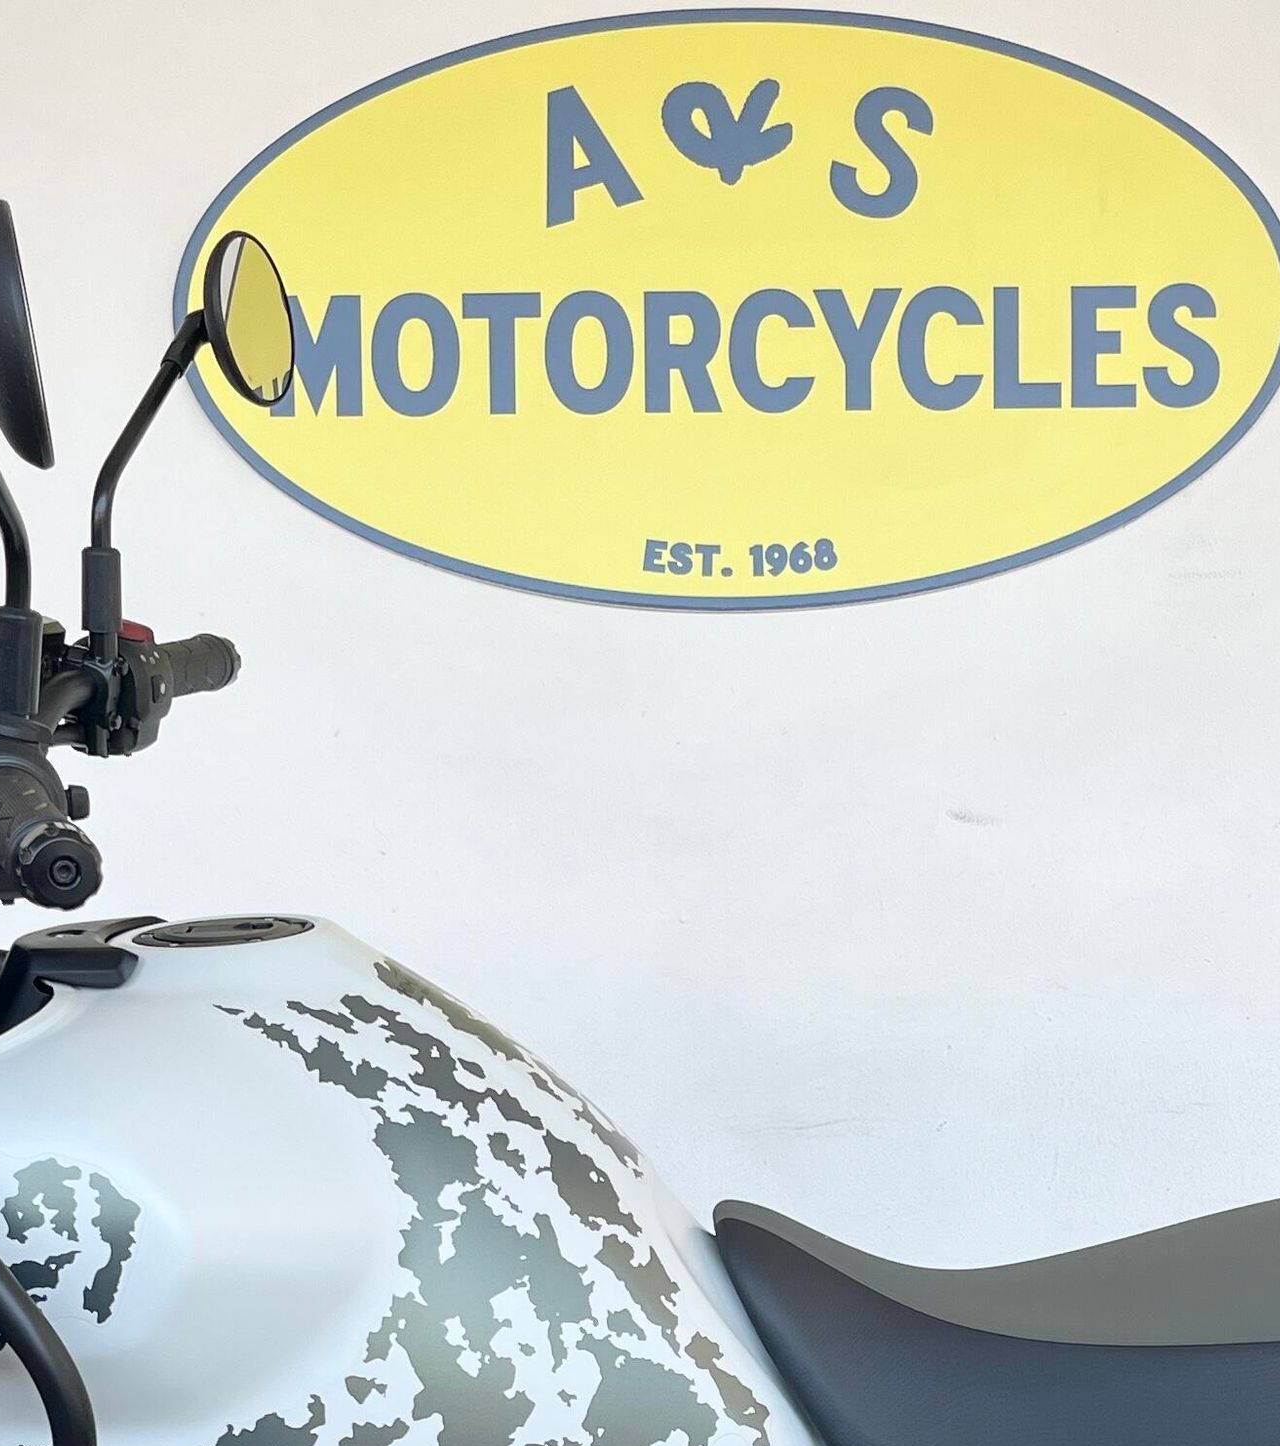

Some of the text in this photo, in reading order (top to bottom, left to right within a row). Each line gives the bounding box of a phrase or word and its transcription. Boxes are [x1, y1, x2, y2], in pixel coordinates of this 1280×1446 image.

[548, 87, 642, 227] A
[830, 87, 933, 218] S
[270, 283, 1221, 417] MOTORCYCLES
[644, 538, 839, 577] EST. 1968
